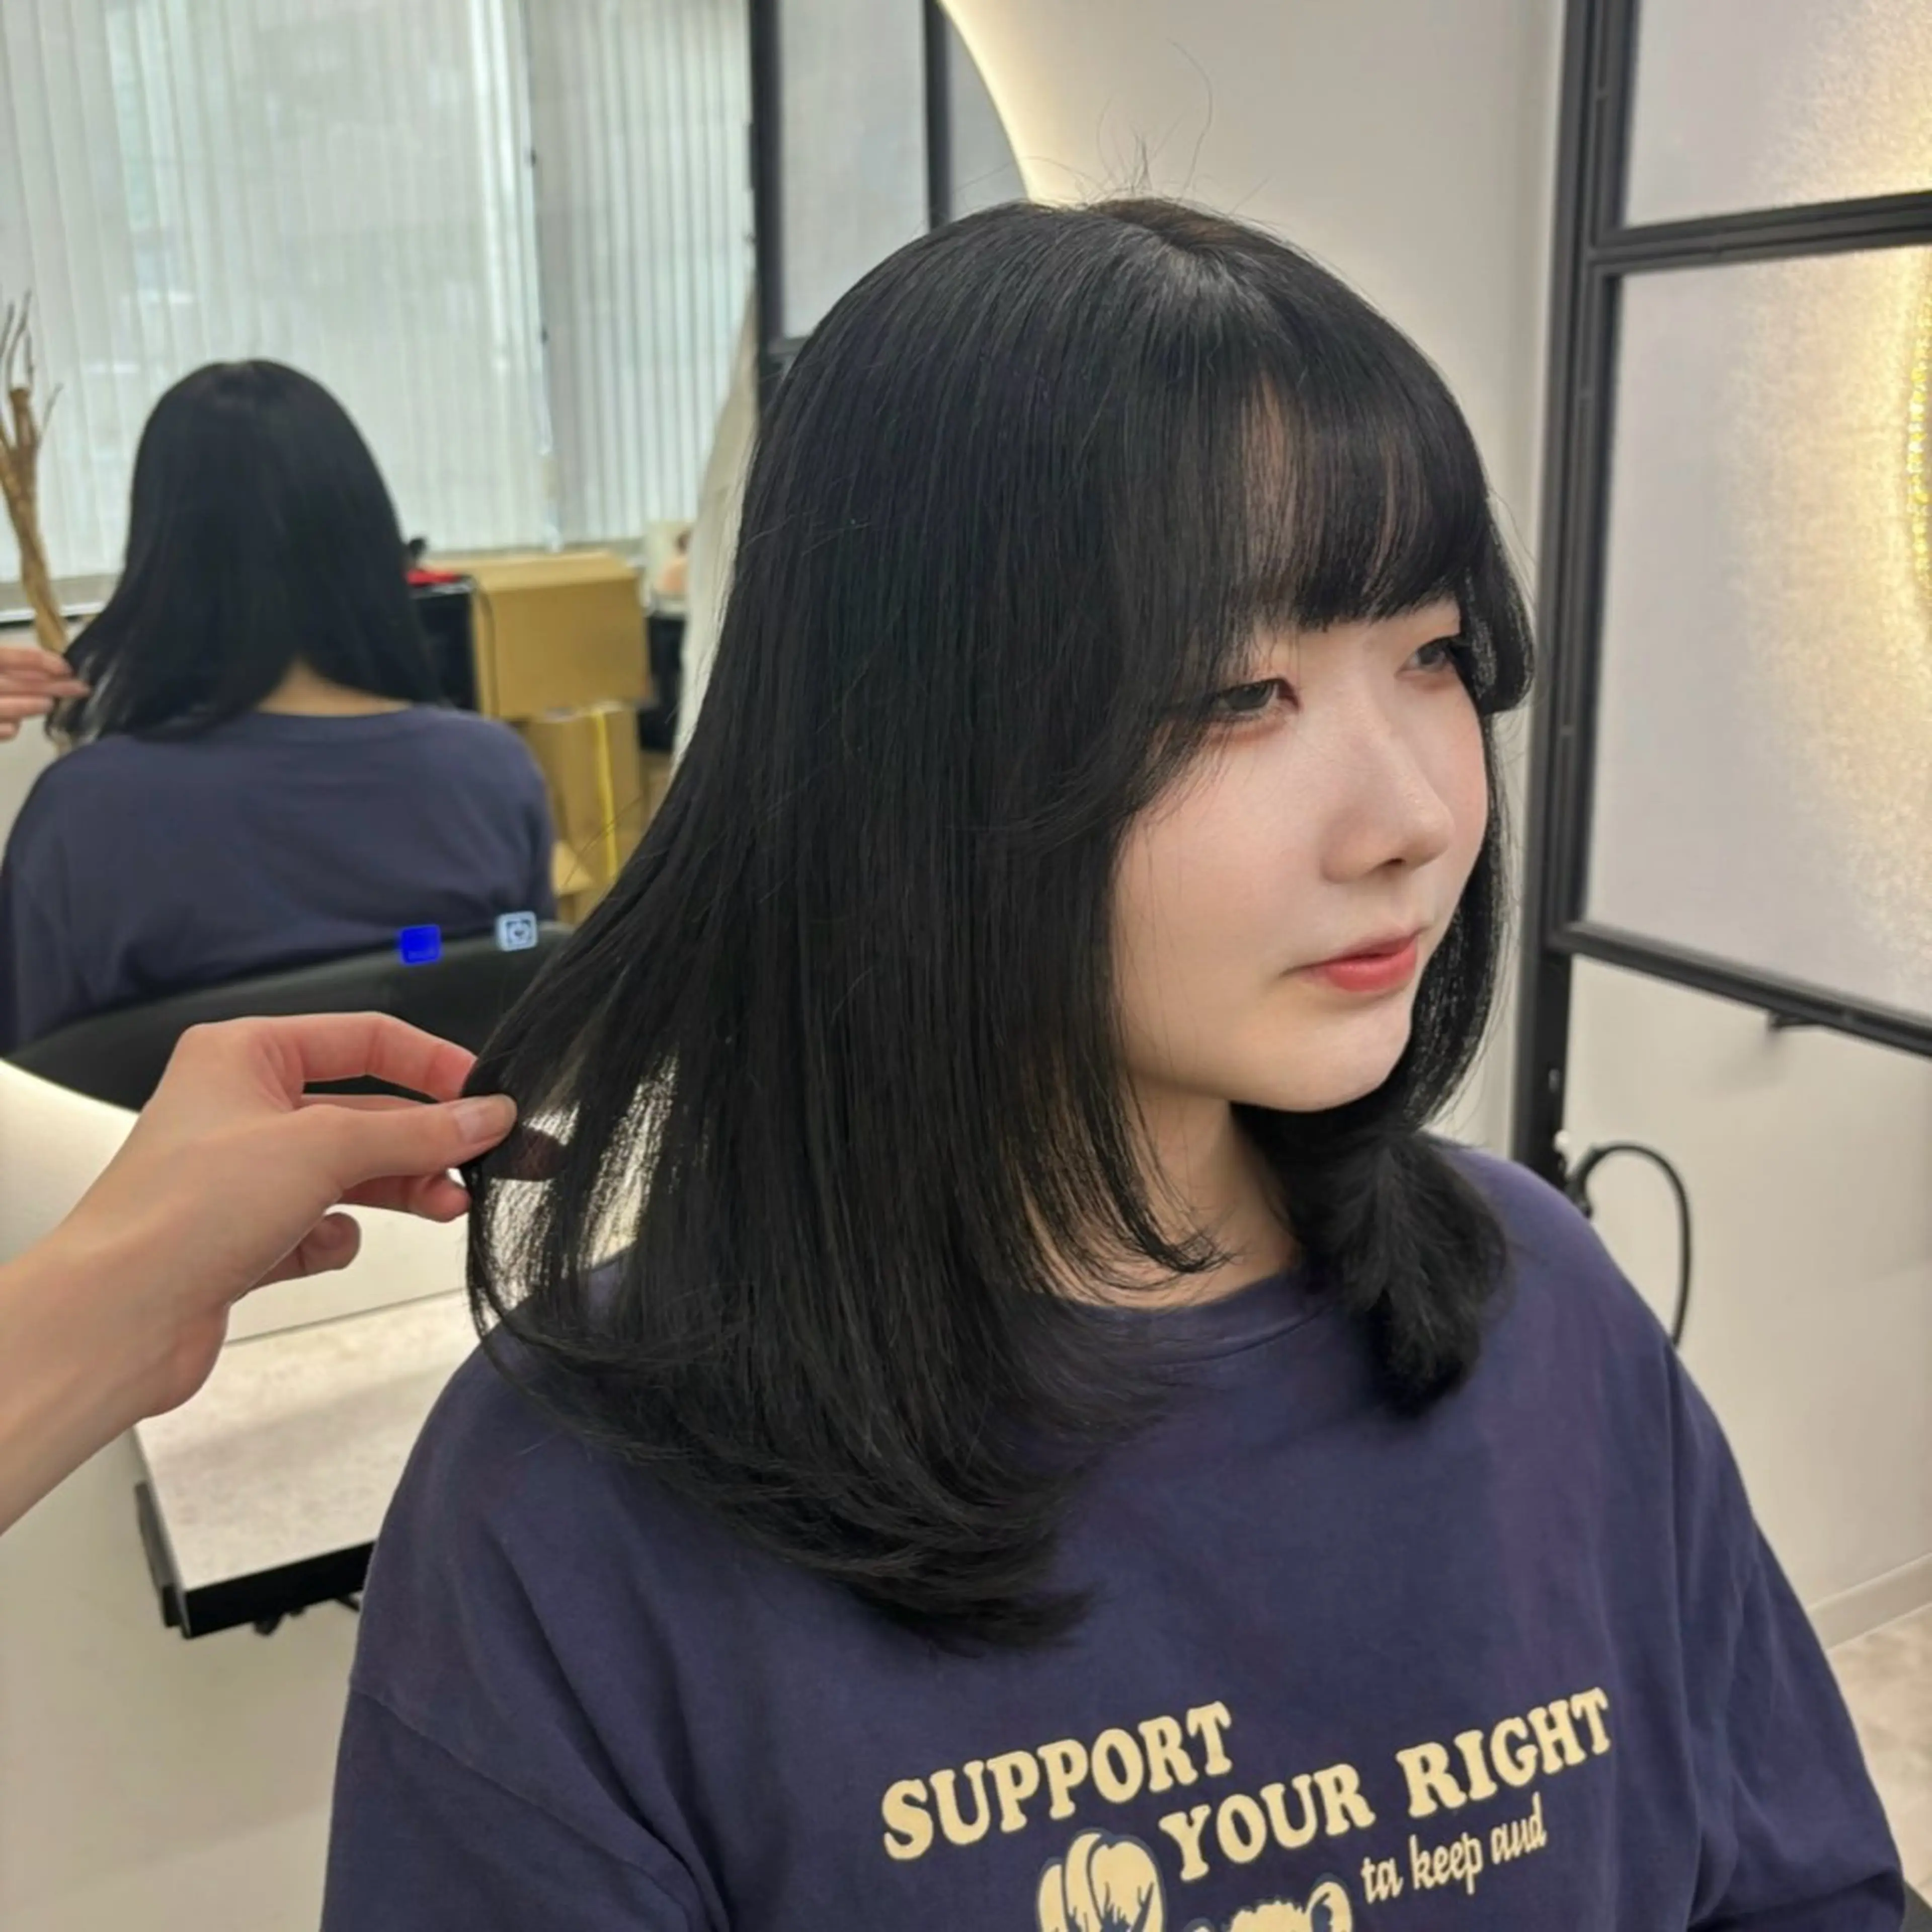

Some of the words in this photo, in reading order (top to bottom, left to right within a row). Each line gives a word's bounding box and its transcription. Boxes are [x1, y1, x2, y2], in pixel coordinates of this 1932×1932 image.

[882, 1701, 1232, 1860] SUPPORT
[1158, 1763, 1377, 1881] YOUR
[1396, 1687, 1611, 1818] RIGHT
[1409, 1832, 1484, 1895] keep
